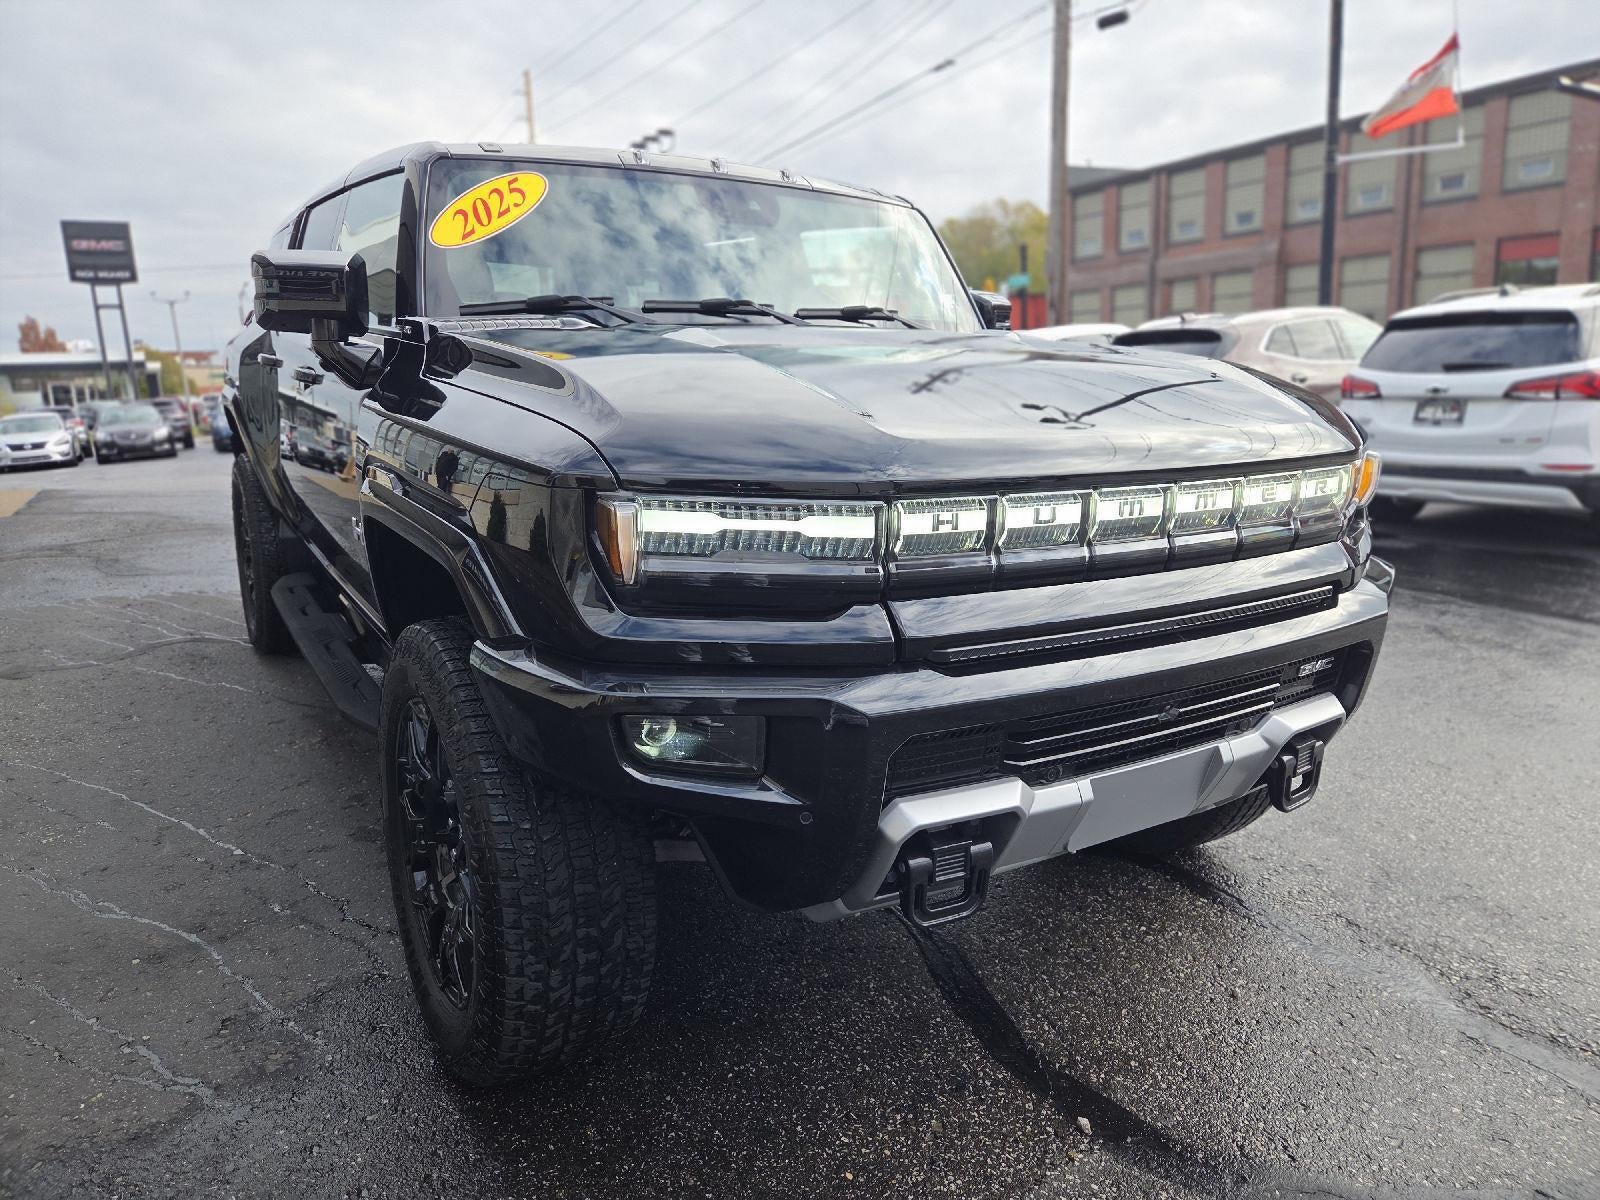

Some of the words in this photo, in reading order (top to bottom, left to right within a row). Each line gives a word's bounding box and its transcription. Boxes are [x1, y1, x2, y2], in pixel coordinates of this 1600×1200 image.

[452, 176, 527, 241] 2025
[931, 479, 1328, 532] HUMMER
[1298, 656, 1335, 677] GMC
